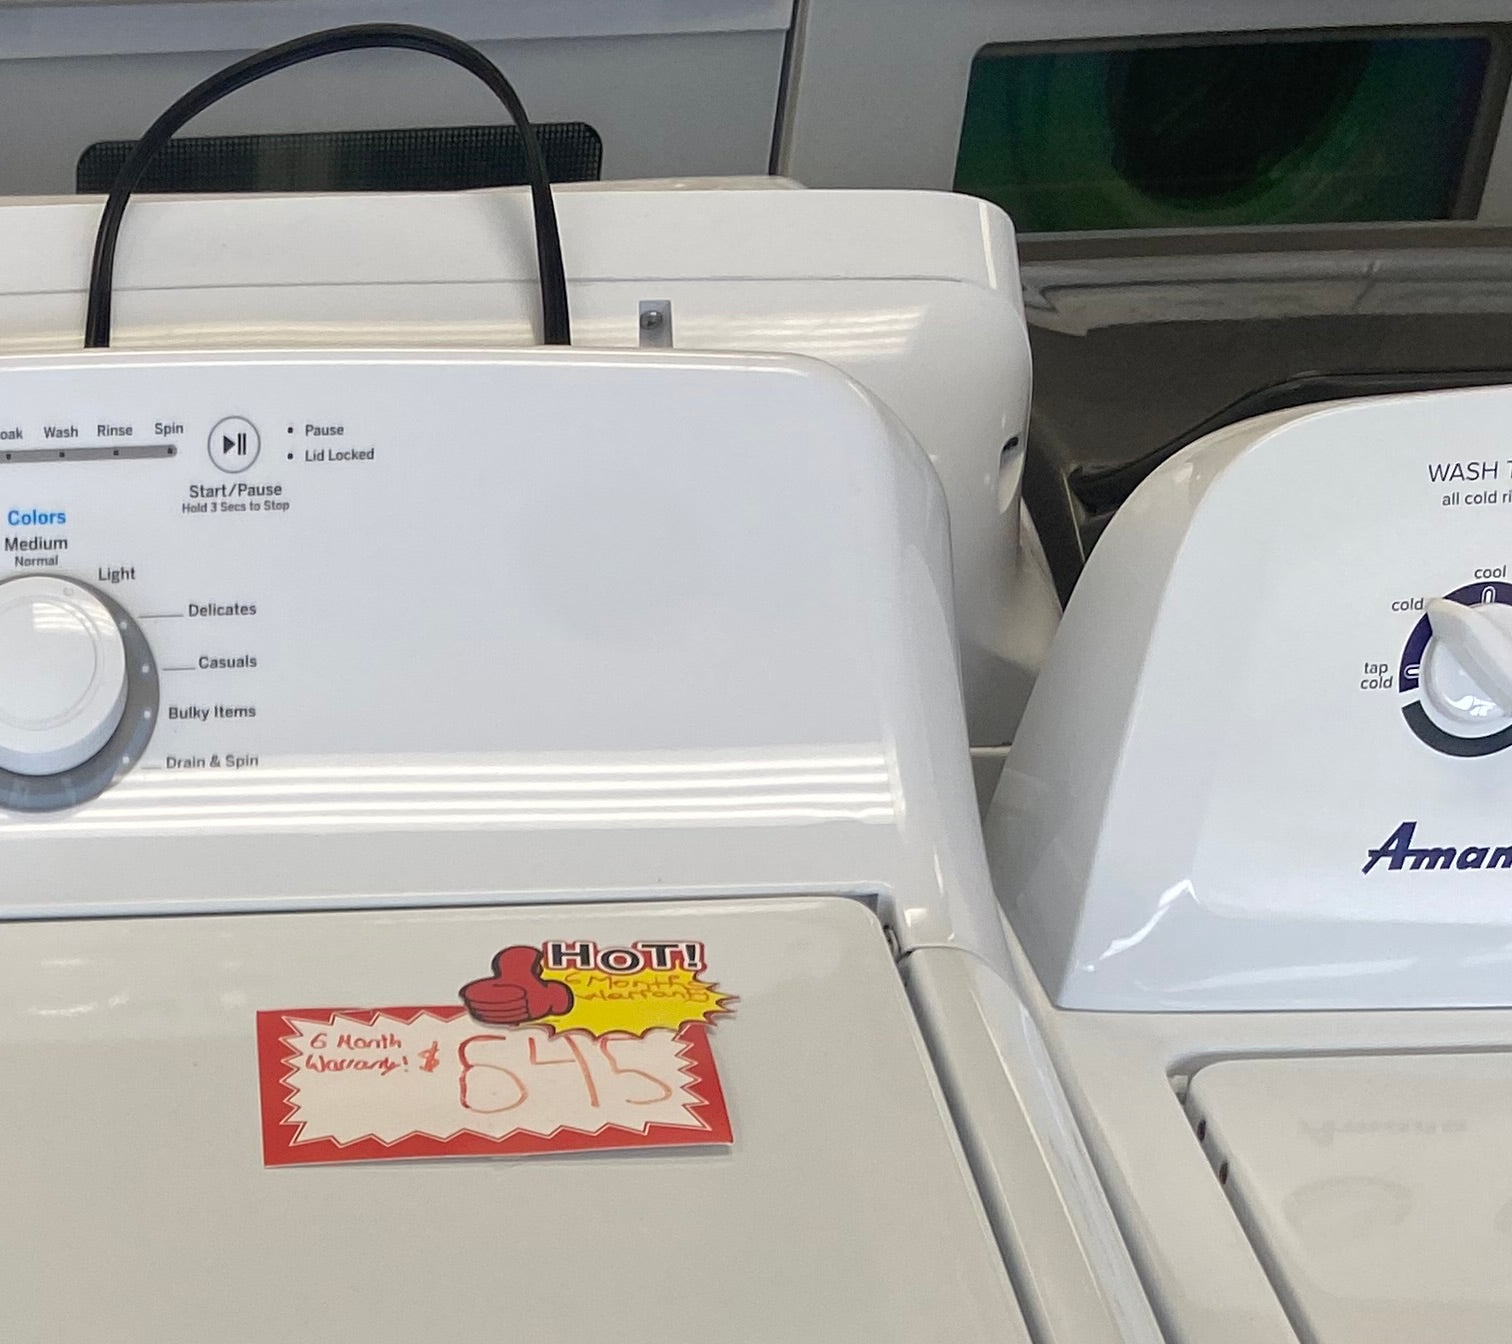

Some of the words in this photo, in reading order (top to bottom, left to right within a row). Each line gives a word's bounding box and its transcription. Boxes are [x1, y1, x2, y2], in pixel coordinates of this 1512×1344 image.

[43, 426, 79, 439] Wash
[97, 424, 133, 437] Rinse
[154, 422, 184, 437] Spin
[305, 424, 345, 437] Pause
[305, 450, 325, 462] Lid
[328, 448, 375, 461] Locked
[1428, 460, 1499, 483] WASH
[189, 483, 283, 498] Start/Pause
[1442, 491, 1460, 506] all
[1465, 490, 1497, 505] cold
[182, 502, 208, 514] Hold
[210, 501, 218, 513] 3
[220, 501, 247, 512] Secs
[249, 501, 261, 511] to
[263, 500, 290, 513] Stop
[8, 509, 66, 526] Colors
[4, 536, 68, 551] Medium
[14, 555, 59, 567] Normal
[98, 566, 136, 584] Light
[1474, 565, 1507, 579] cool
[188, 603, 257, 618] Delicates
[1391, 597, 1425, 612] cold
[198, 654, 258, 669] Casuals
[1364, 661, 1389, 678] tap
[1360, 675, 1393, 690] cold
[168, 706, 210, 722] Bulky
[214, 705, 256, 719] Items
[166, 756, 206, 770] Drain
[209, 755, 221, 768] &
[225, 755, 259, 770] Spin
[310, 1032, 328, 1050] 6
[337, 1033, 402, 1050] Month
